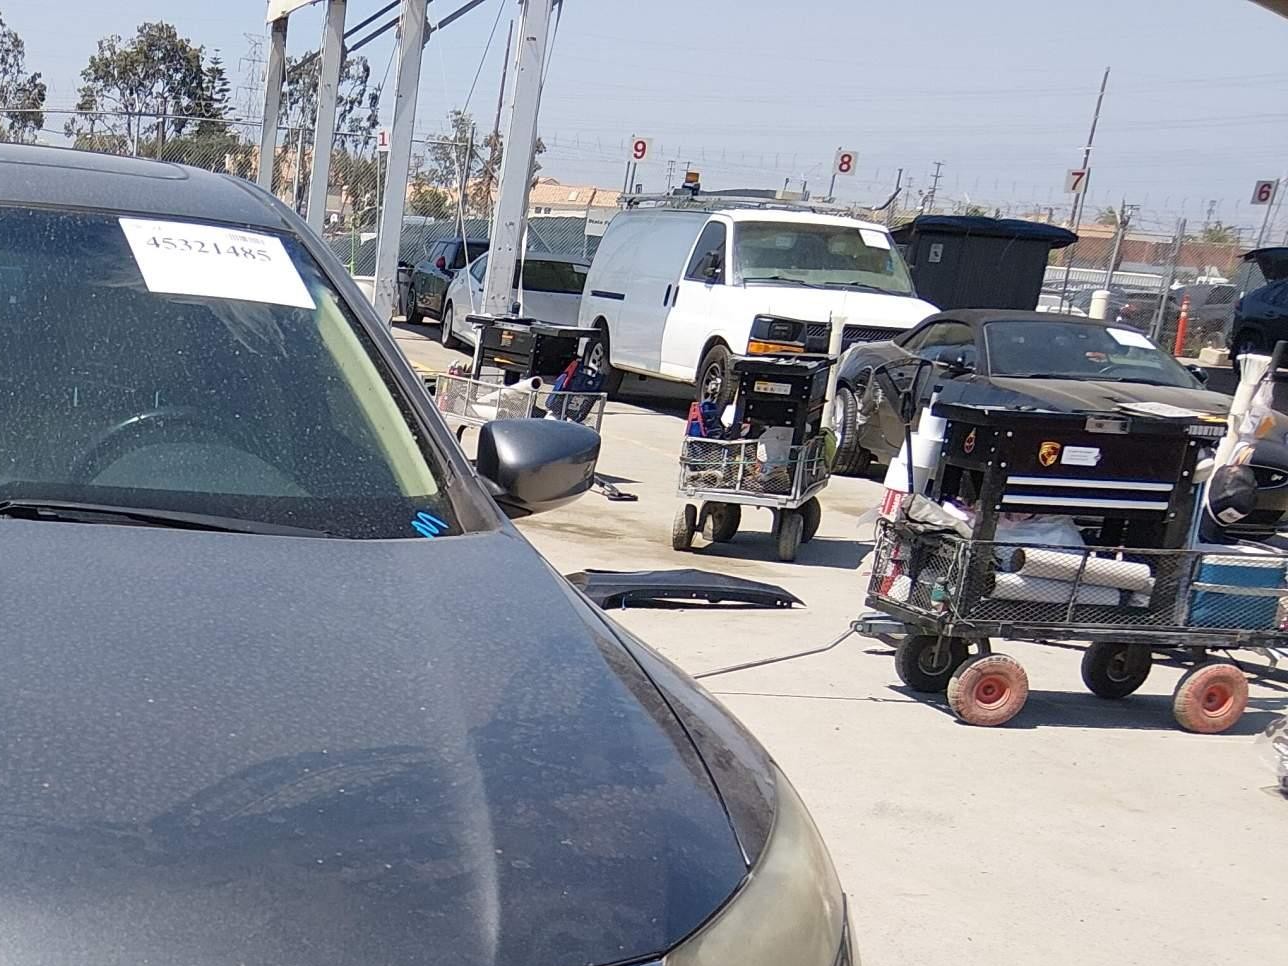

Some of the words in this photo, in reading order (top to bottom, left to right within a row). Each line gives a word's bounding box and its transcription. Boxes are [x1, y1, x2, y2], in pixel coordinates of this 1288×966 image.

[633, 140, 647, 160] 9
[838, 153, 852, 173] 8
[1071, 171, 1085, 191] 7
[1257, 183, 1272, 202] 6
[146, 235, 272, 263] 45321485
